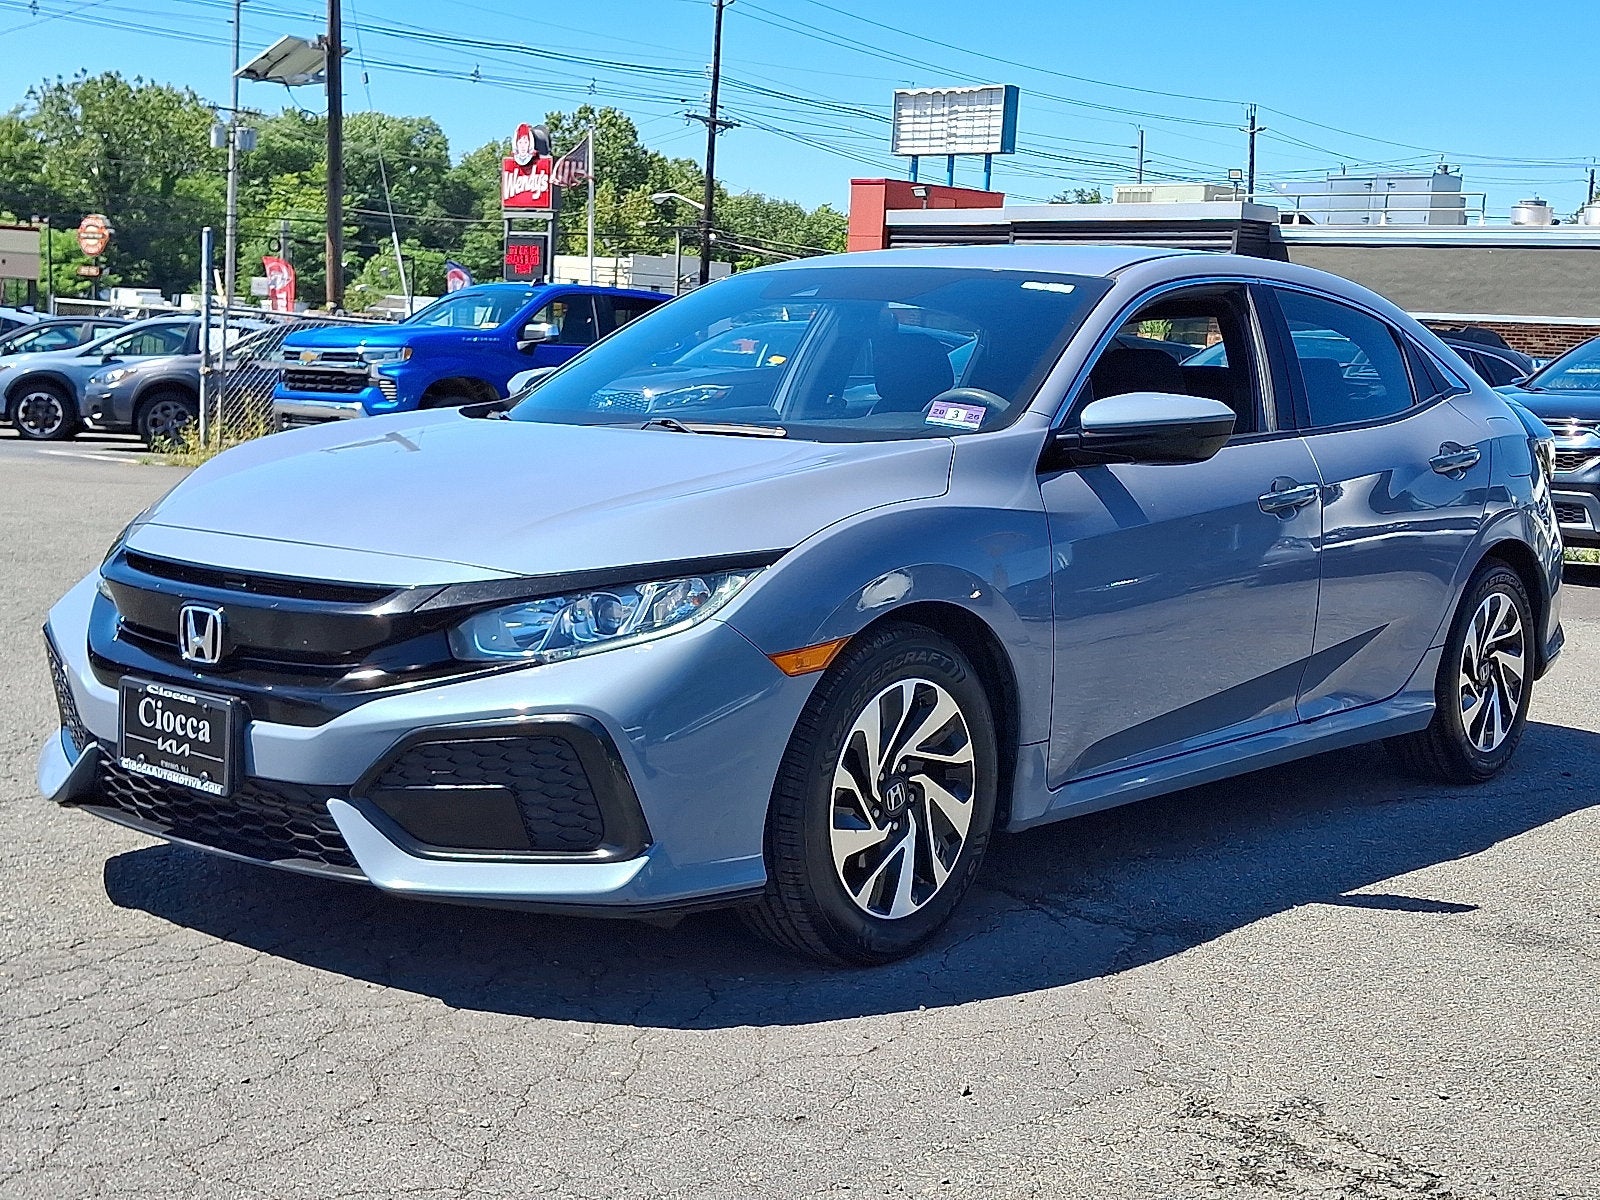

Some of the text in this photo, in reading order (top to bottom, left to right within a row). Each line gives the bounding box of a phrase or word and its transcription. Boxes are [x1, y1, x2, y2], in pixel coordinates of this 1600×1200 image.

[503, 165, 549, 200] Wendy's
[952, 409, 960, 418] 3
[146, 684, 197, 704] Ciocca
[138, 697, 211, 743] Ciocca
